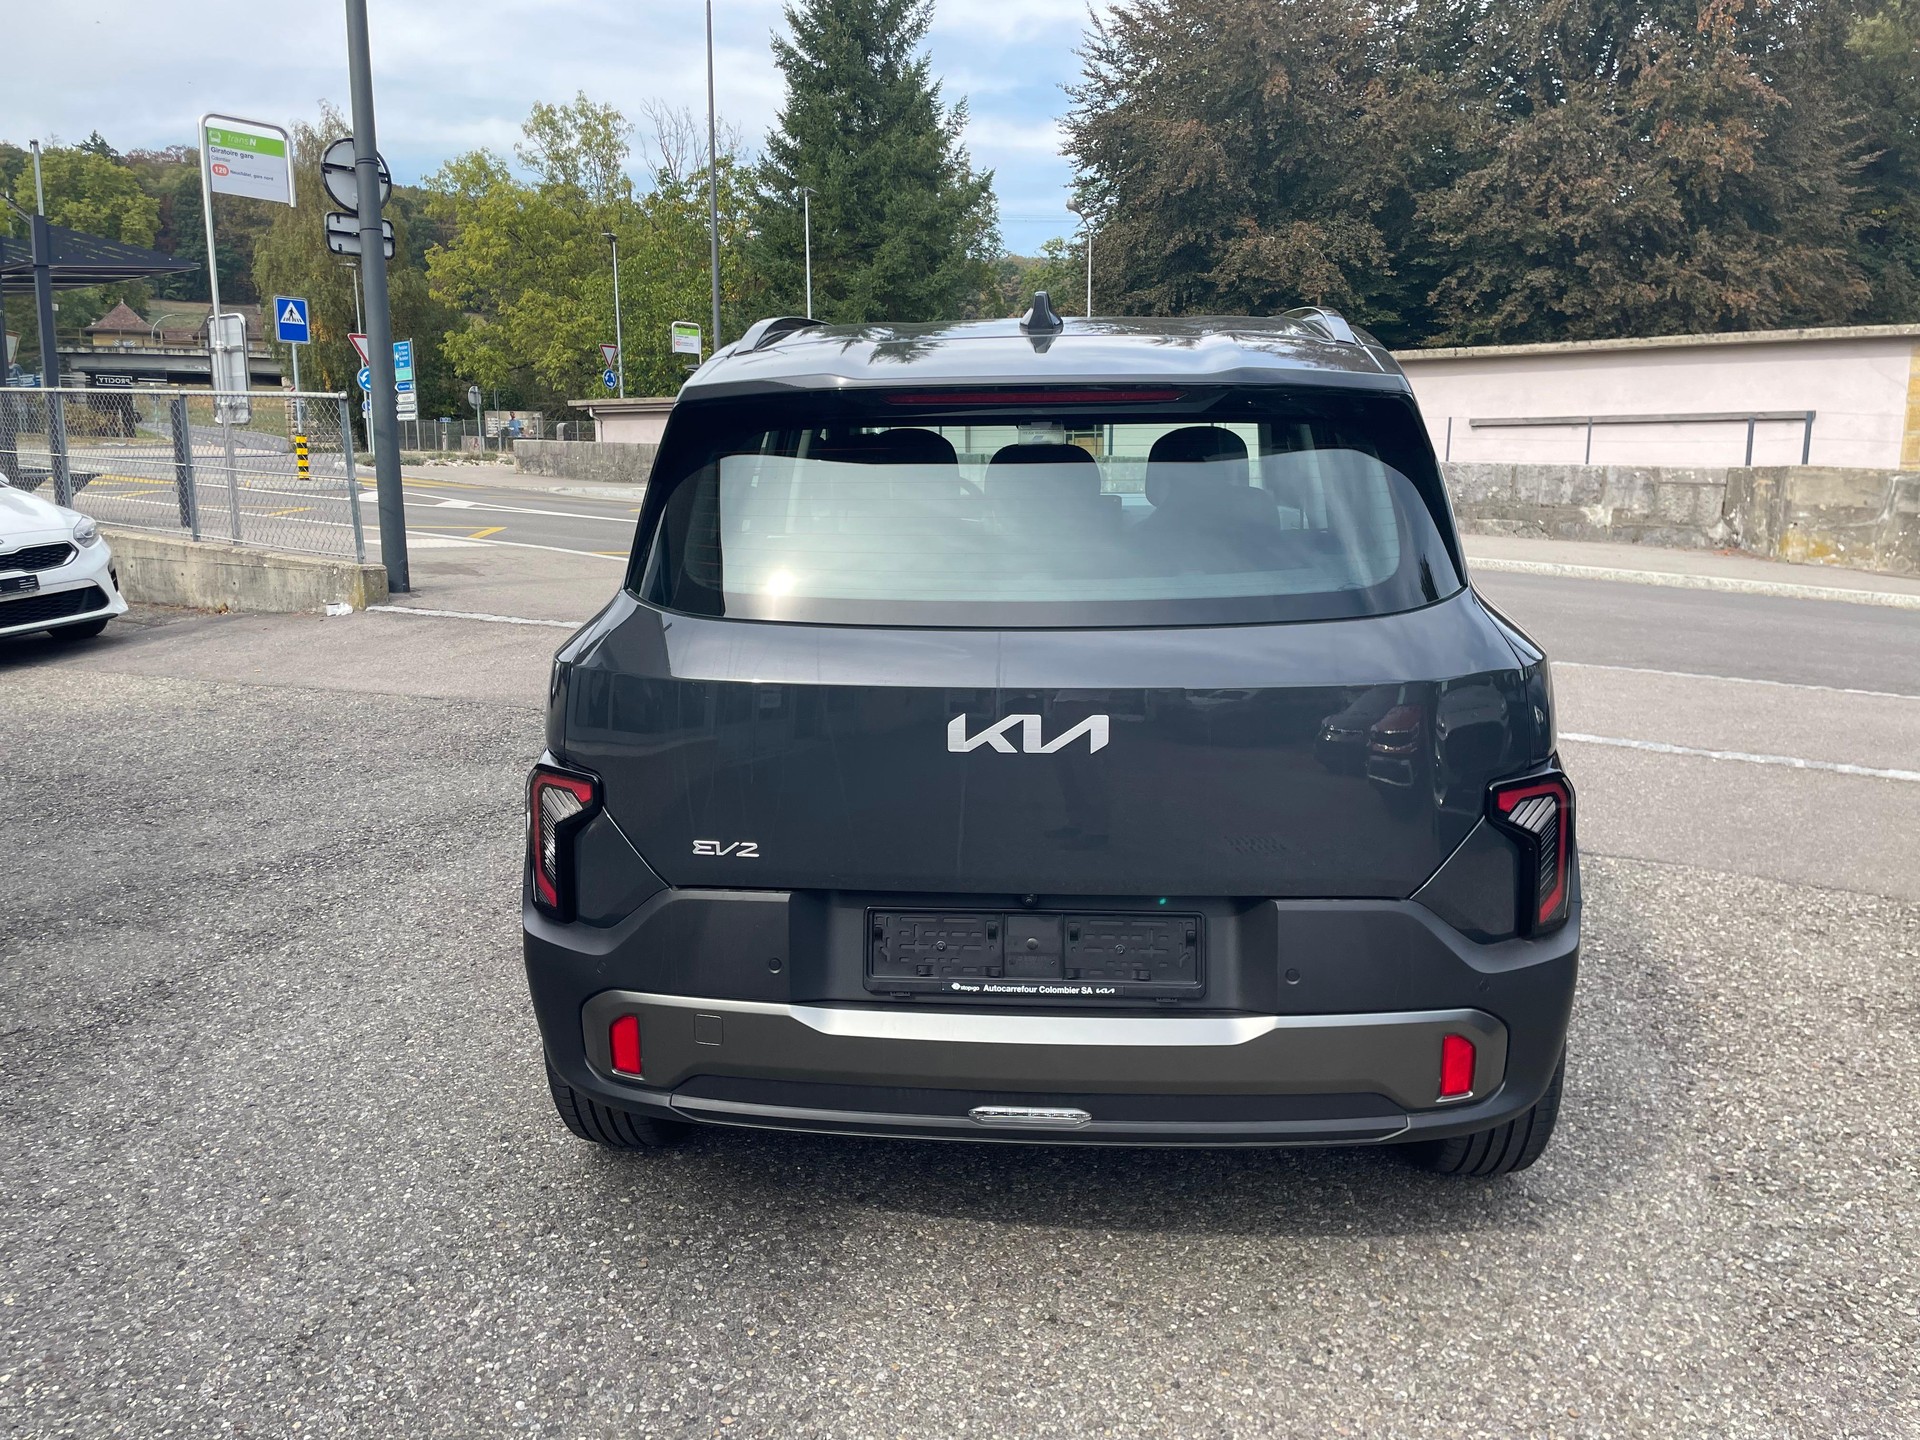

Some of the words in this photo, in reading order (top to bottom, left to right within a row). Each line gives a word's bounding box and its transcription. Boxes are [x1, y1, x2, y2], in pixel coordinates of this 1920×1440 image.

[210, 146, 239, 157] Giratoire
[239, 152, 254, 160] gare
[214, 165, 227, 175] 120
[947, 713, 1110, 755] KIA
[692, 839, 760, 858] EV2
[983, 984, 1037, 993] Autocarrefour
[1038, 985, 1080, 994] Colombier
[1080, 986, 1093, 994] SA
